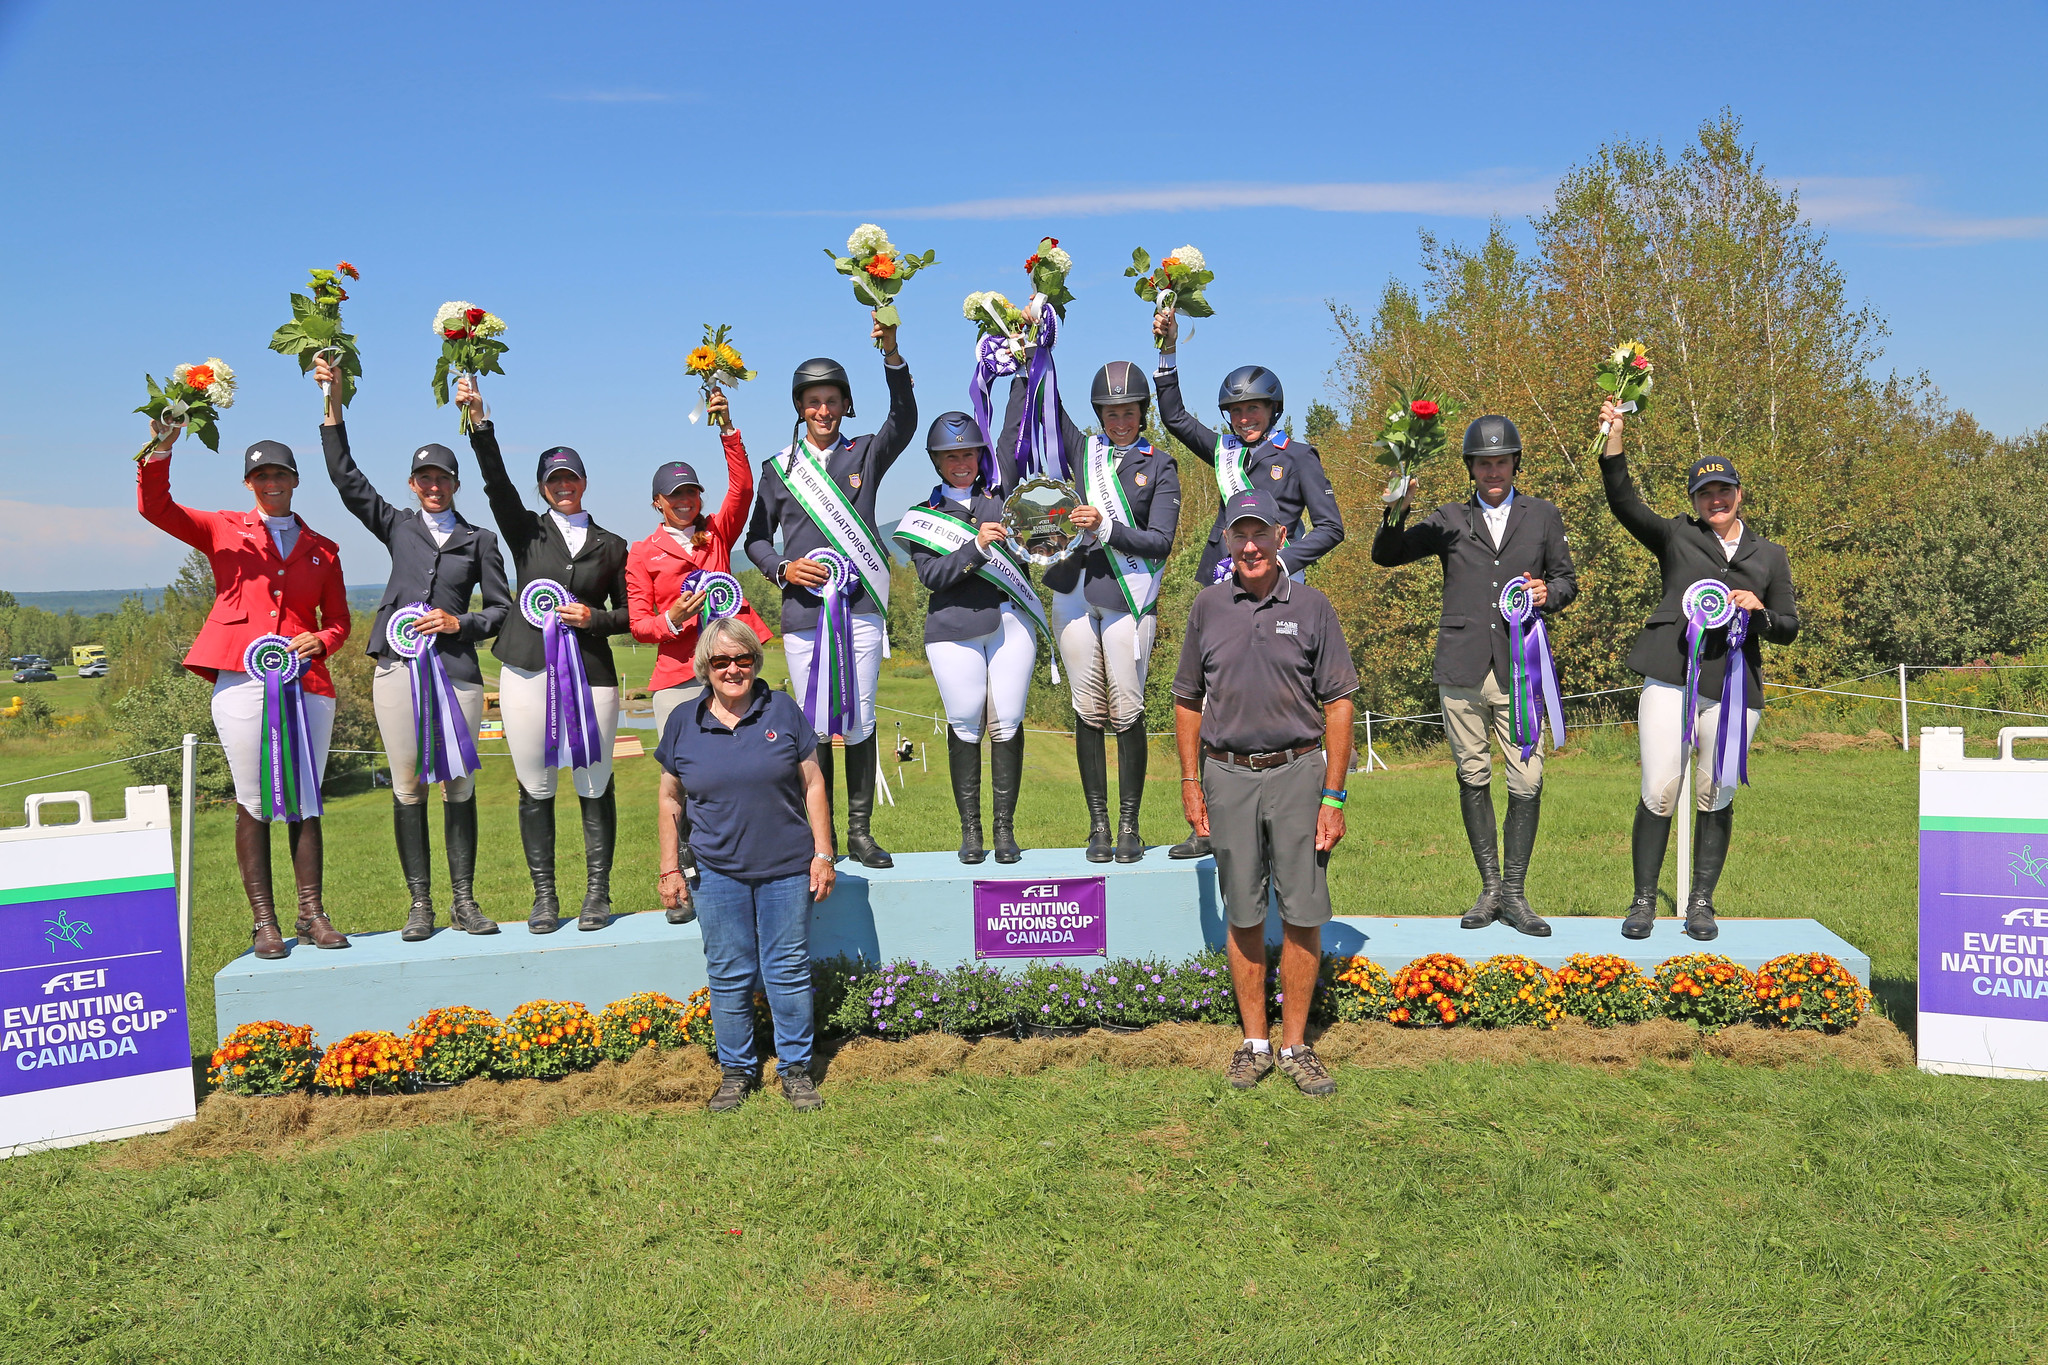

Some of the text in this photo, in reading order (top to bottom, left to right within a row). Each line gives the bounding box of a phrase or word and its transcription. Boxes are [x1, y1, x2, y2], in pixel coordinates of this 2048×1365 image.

[1094, 454, 1110, 501] EVENTING
[1697, 463, 1725, 477] AUS
[796, 466, 835, 513] EVENTING
[831, 510, 866, 554] NATIONS
[862, 552, 879, 572] CUP
[911, 519, 934, 531] FEI
[987, 557, 1021, 587] ATIONS
[265, 656, 281, 666] 2nd
[1021, 884, 1060, 898] FEI
[1000, 901, 1080, 916] EVENTING
[987, 916, 1058, 931] NATIONS
[1005, 930, 1075, 944] CANADA
[1941, 952, 2048, 978] NATION
[41, 968, 108, 995] FEI
[1972, 976, 2048, 1000] CANA
[3, 991, 144, 1029] EVENTING
[0, 1018, 107, 1051] ATIONS
[16, 1035, 138, 1071] CANADA
